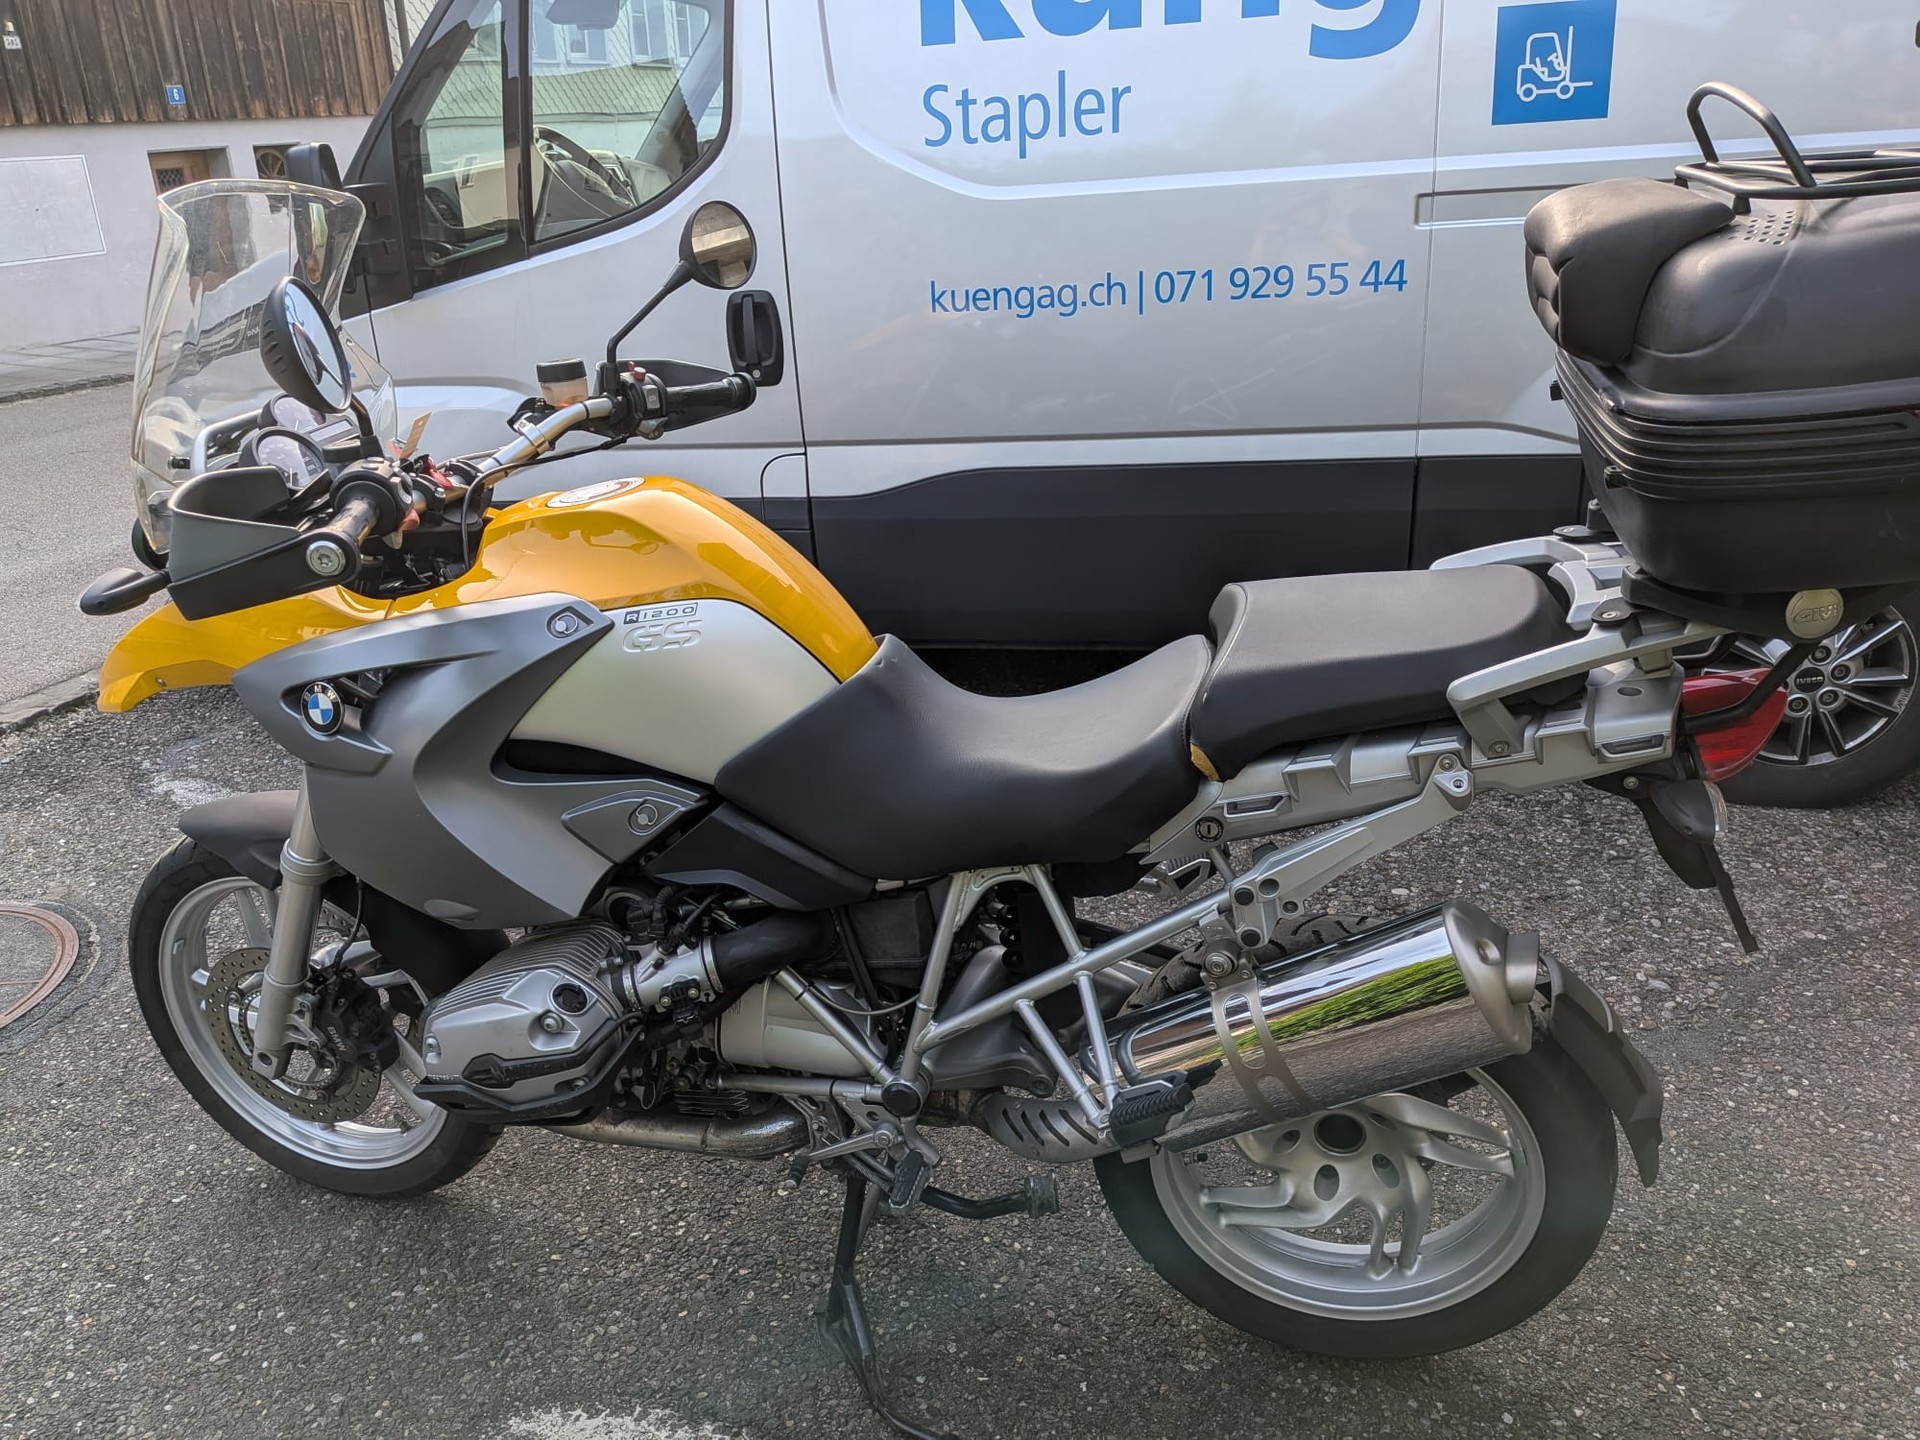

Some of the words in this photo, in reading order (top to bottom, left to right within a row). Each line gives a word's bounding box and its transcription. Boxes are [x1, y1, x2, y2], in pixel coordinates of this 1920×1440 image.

[173, 88, 180, 101] 6
[922, 70, 1132, 159] Stapler
[930, 272, 1127, 319] kuengag.ch
[1154, 269, 1213, 304] 071
[1229, 264, 1294, 300] 929
[1306, 261, 1349, 297] 55
[1359, 259, 1408, 293] 44
[1793, 604, 1839, 623] GIVI
[623, 619, 702, 653] GS
[1796, 676, 1824, 685] IVECO
[303, 684, 337, 701] BMW
[327, 1026, 347, 1051] BMW
